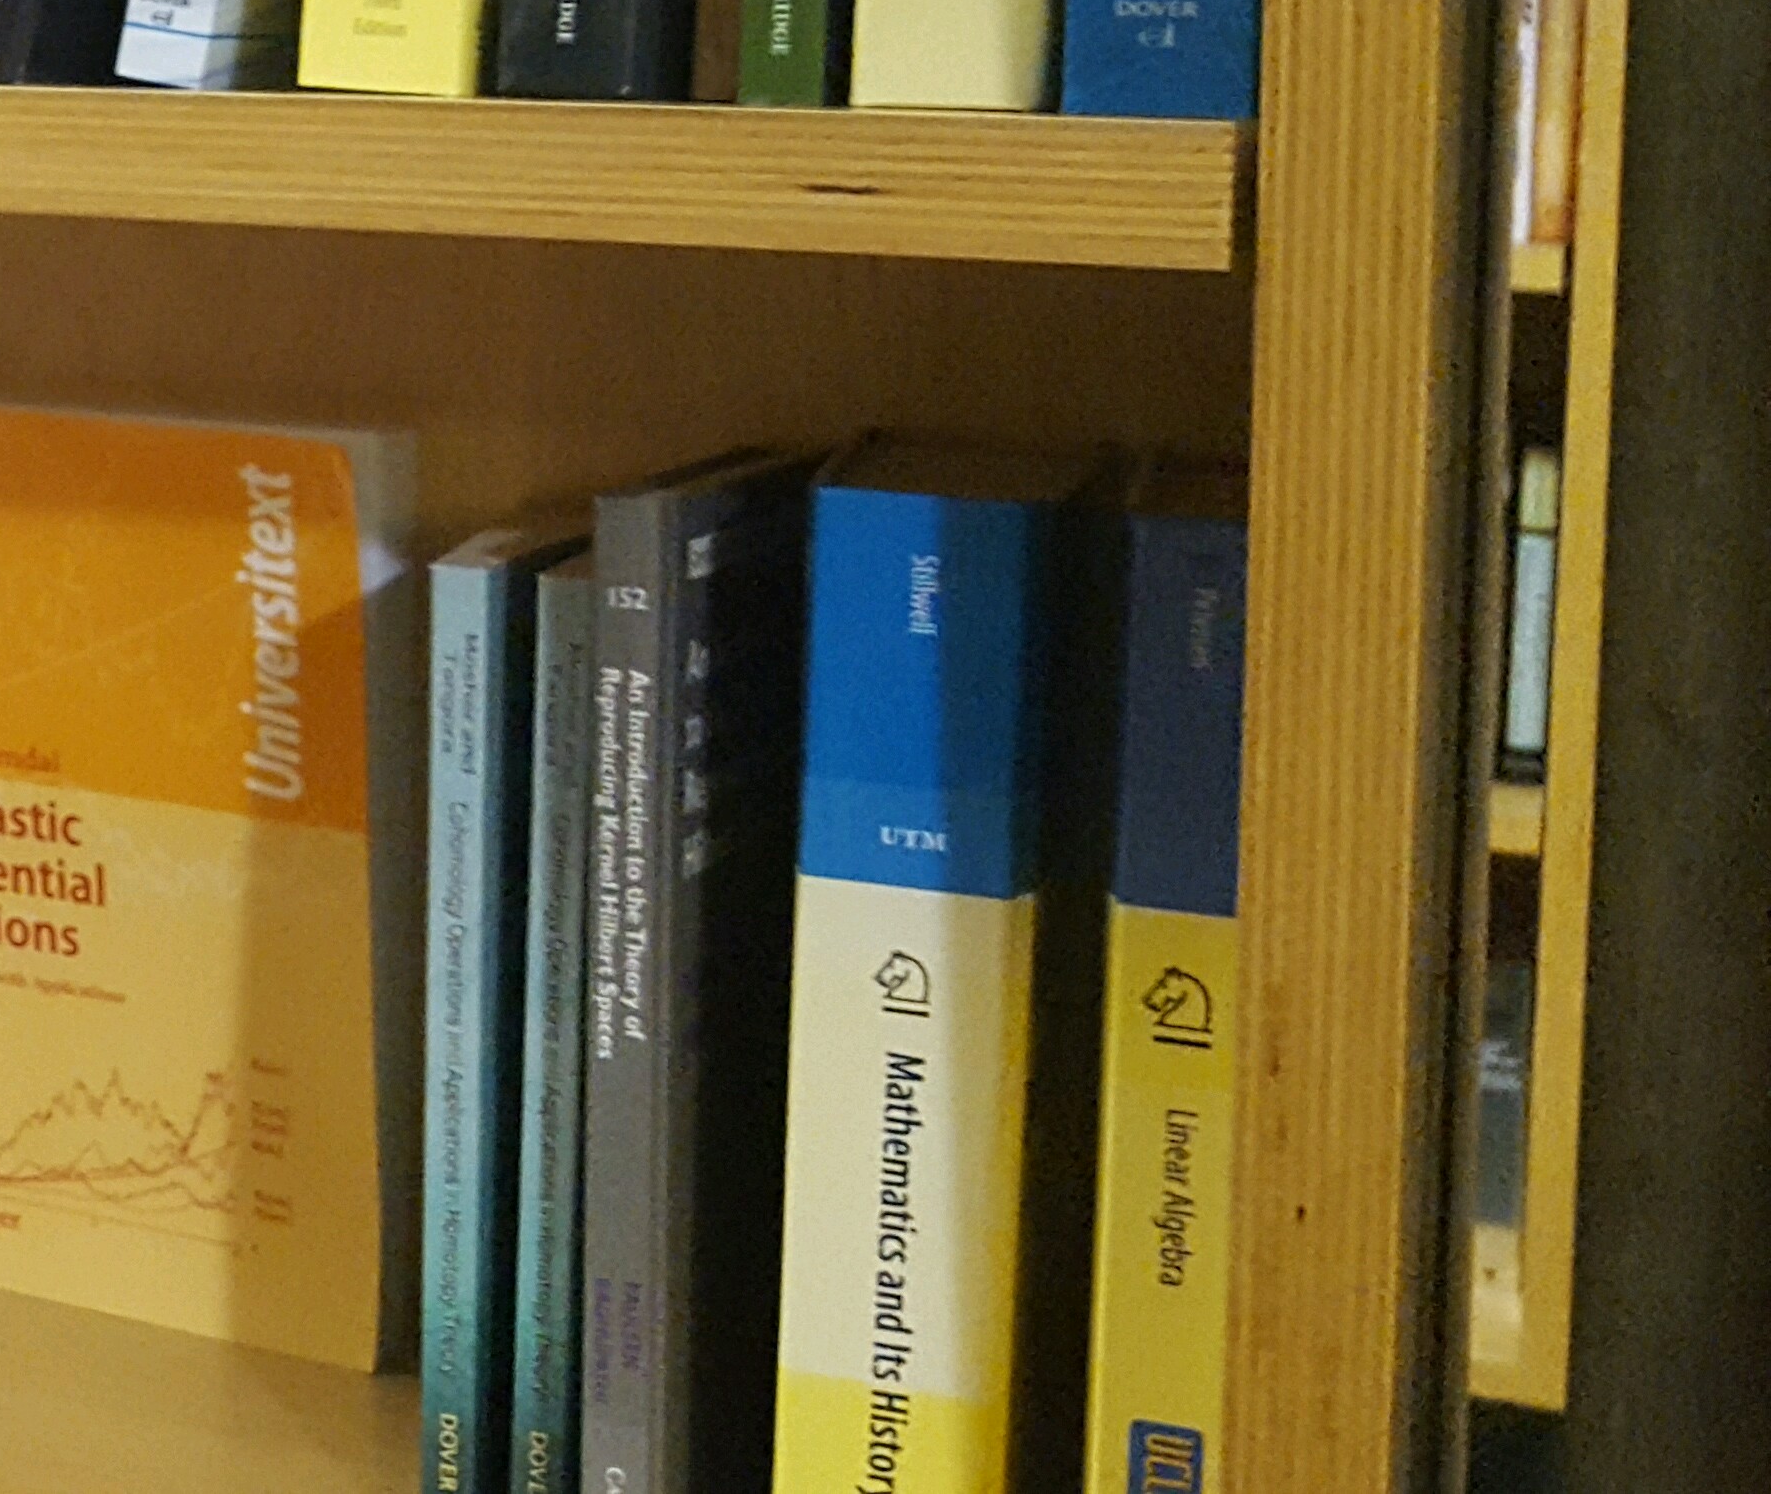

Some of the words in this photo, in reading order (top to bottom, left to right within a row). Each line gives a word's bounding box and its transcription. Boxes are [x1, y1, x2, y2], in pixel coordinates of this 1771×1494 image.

[234, 463, 305, 803] Universitext
[627, 668, 651, 705] An
[594, 666, 622, 810] Reproducing
[625, 709, 651, 853] Introduction
[594, 813, 620, 886] Kernel
[626, 858, 647, 883] to
[879, 824, 948, 853] UTM
[592, 888, 619, 976] Hilbert
[624, 888, 648, 930] the
[622, 933, 648, 1005] Theory
[878, 1051, 928, 1266] Mathematics
[1164, 1108, 1200, 1190] Linear
[1153, 1193, 1195, 1288] Algebra
[874, 1273, 908, 1335] and
[871, 1340, 915, 1382] Its
[437, 1413, 458, 1493] DOVER
[857, 1388, 910, 1494] History
